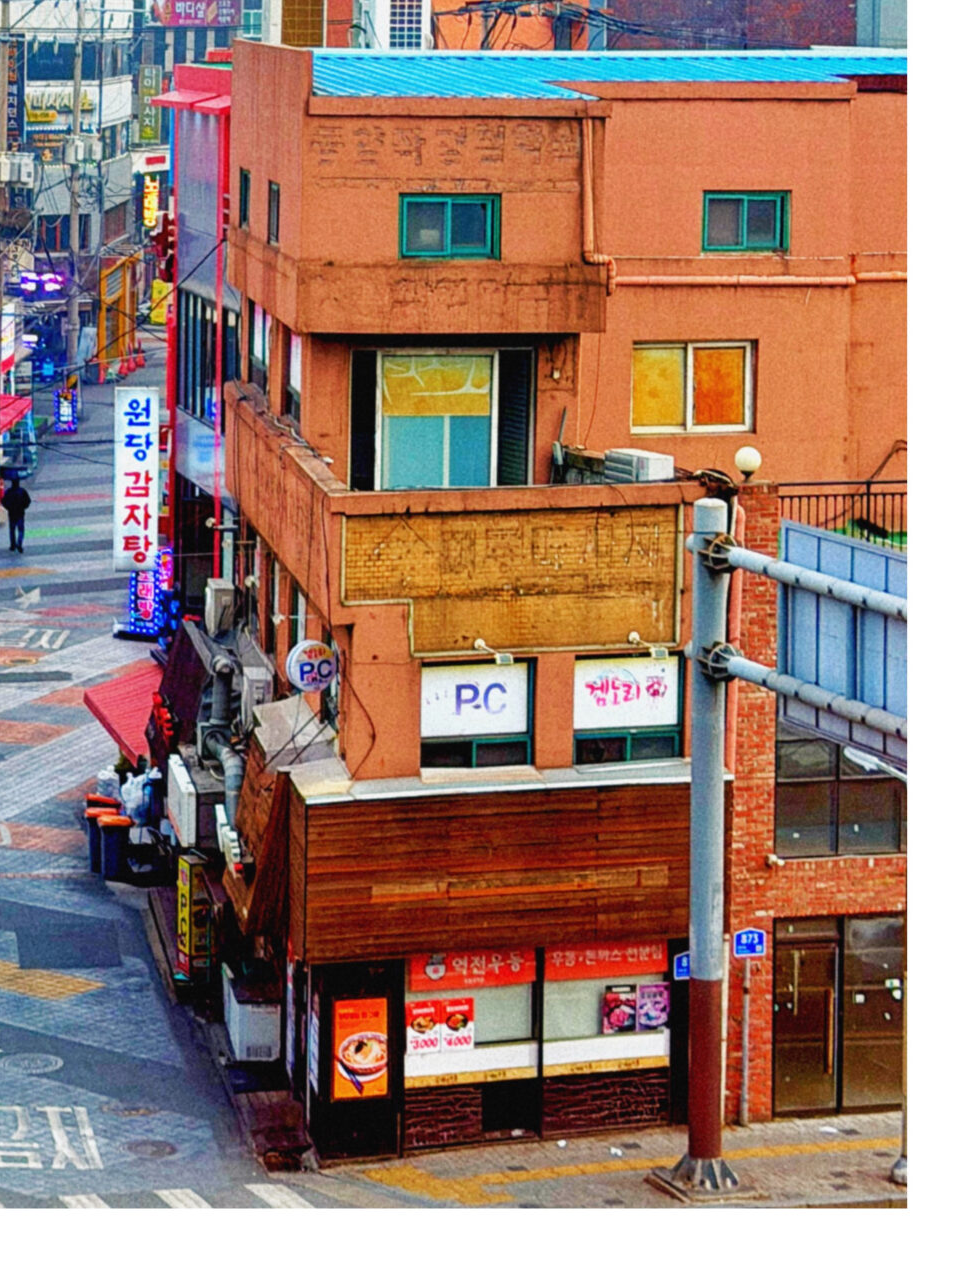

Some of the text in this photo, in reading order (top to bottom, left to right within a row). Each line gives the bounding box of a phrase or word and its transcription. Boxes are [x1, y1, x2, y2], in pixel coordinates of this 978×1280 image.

[122, 397, 154, 564] 원당 감자탕
[740, 933, 760, 945] 873
[452, 951, 524, 976] 역전우동
